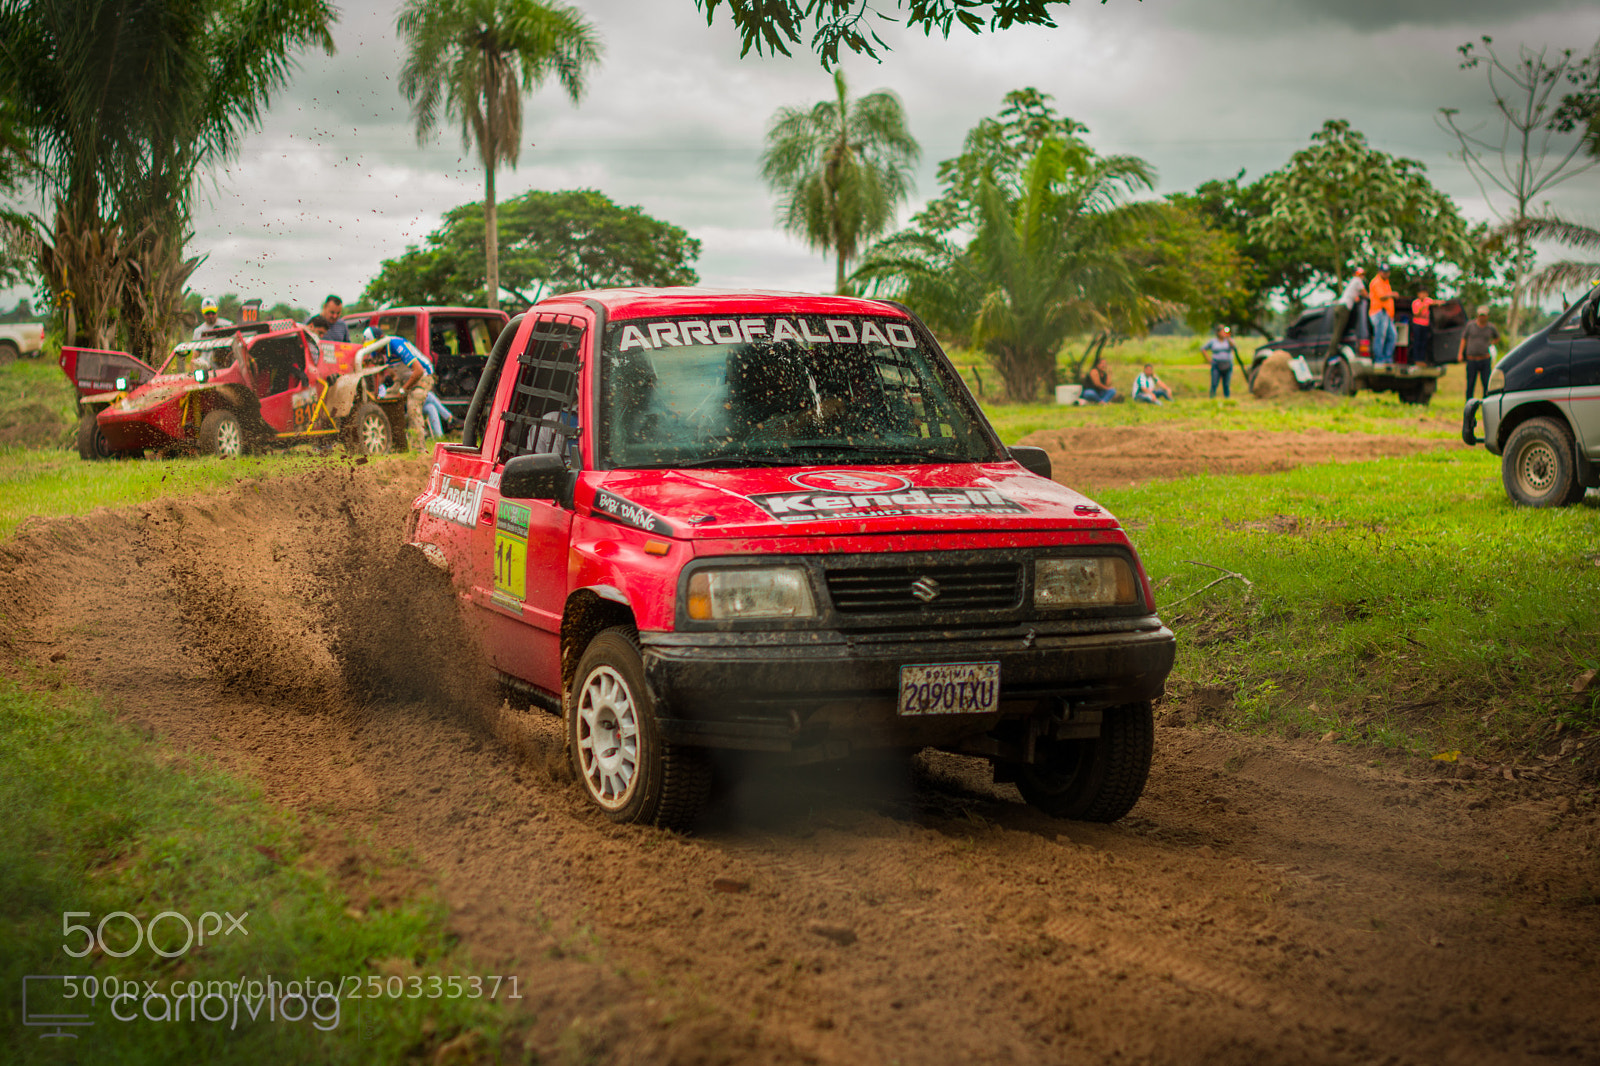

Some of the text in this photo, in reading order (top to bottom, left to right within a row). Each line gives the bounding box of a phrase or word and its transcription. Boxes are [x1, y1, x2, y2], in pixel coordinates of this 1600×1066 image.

[242, 309, 258, 322] 810
[619, 318, 917, 352] ARROFALDAO
[766, 490, 1006, 513] Kendall
[926, 669, 975, 679] BOLIVIA
[905, 681, 993, 711] 2090TXU
